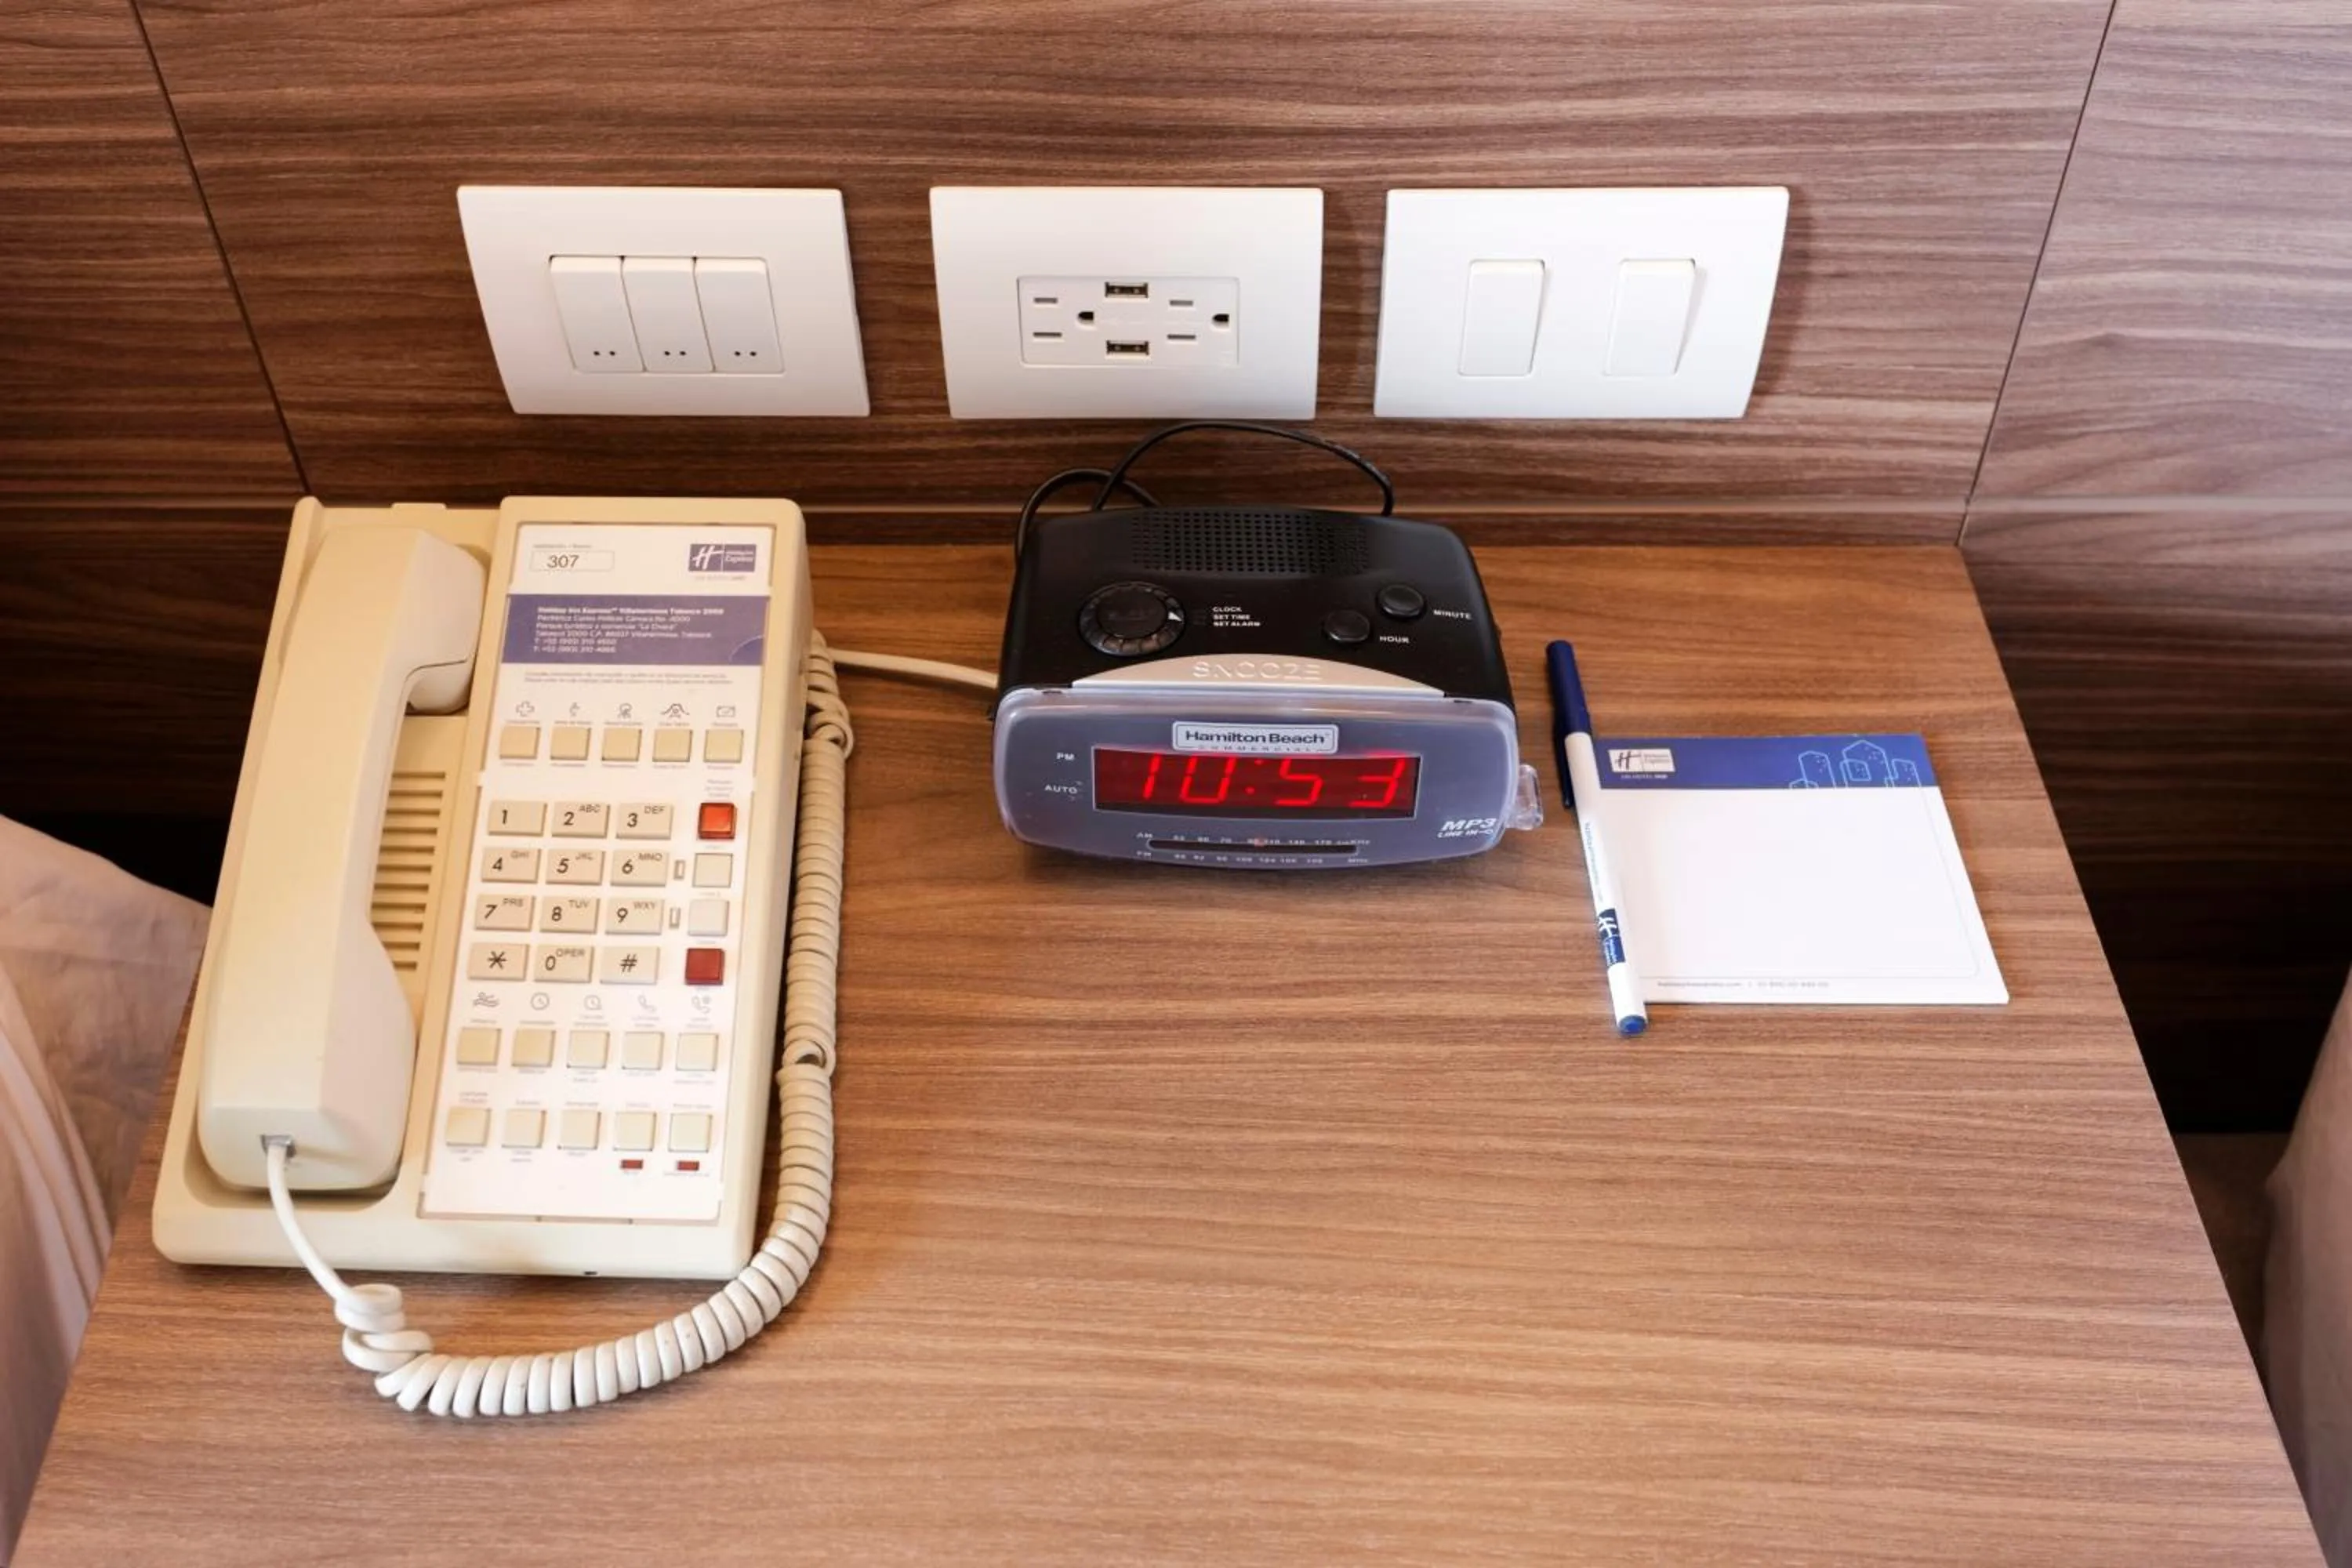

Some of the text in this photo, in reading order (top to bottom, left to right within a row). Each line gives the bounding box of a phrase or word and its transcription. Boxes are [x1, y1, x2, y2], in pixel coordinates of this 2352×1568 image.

[546, 554, 579, 568] 307
[1433, 609, 1472, 620] MINUTE
[1379, 635, 1410, 644] HOUR
[1192, 661, 1323, 681] SNOOZE
[1185, 730, 1326, 744] Hamilton Beach
[1056, 752, 1075, 760] PM
[1142, 752, 1408, 808] 10:53
[1044, 784, 1078, 794] AUTO
[579, 804, 601, 814] ABC
[644, 805, 666, 815] DEF
[501, 809, 509, 825] 1
[563, 811, 575, 827] 2
[626, 812, 639, 828] 3
[1441, 817, 1497, 832] MP3
[638, 851, 663, 862] MNO
[492, 857, 504, 872] 4
[556, 858, 571, 874] 5
[621, 858, 634, 875] 6
[568, 899, 590, 909] TUV
[633, 901, 657, 910] WXY
[483, 904, 499, 920] 7
[550, 906, 563, 922] 8
[616, 906, 629, 924] 9
[555, 948, 586, 958] OPER
[545, 955, 557, 971] 0
